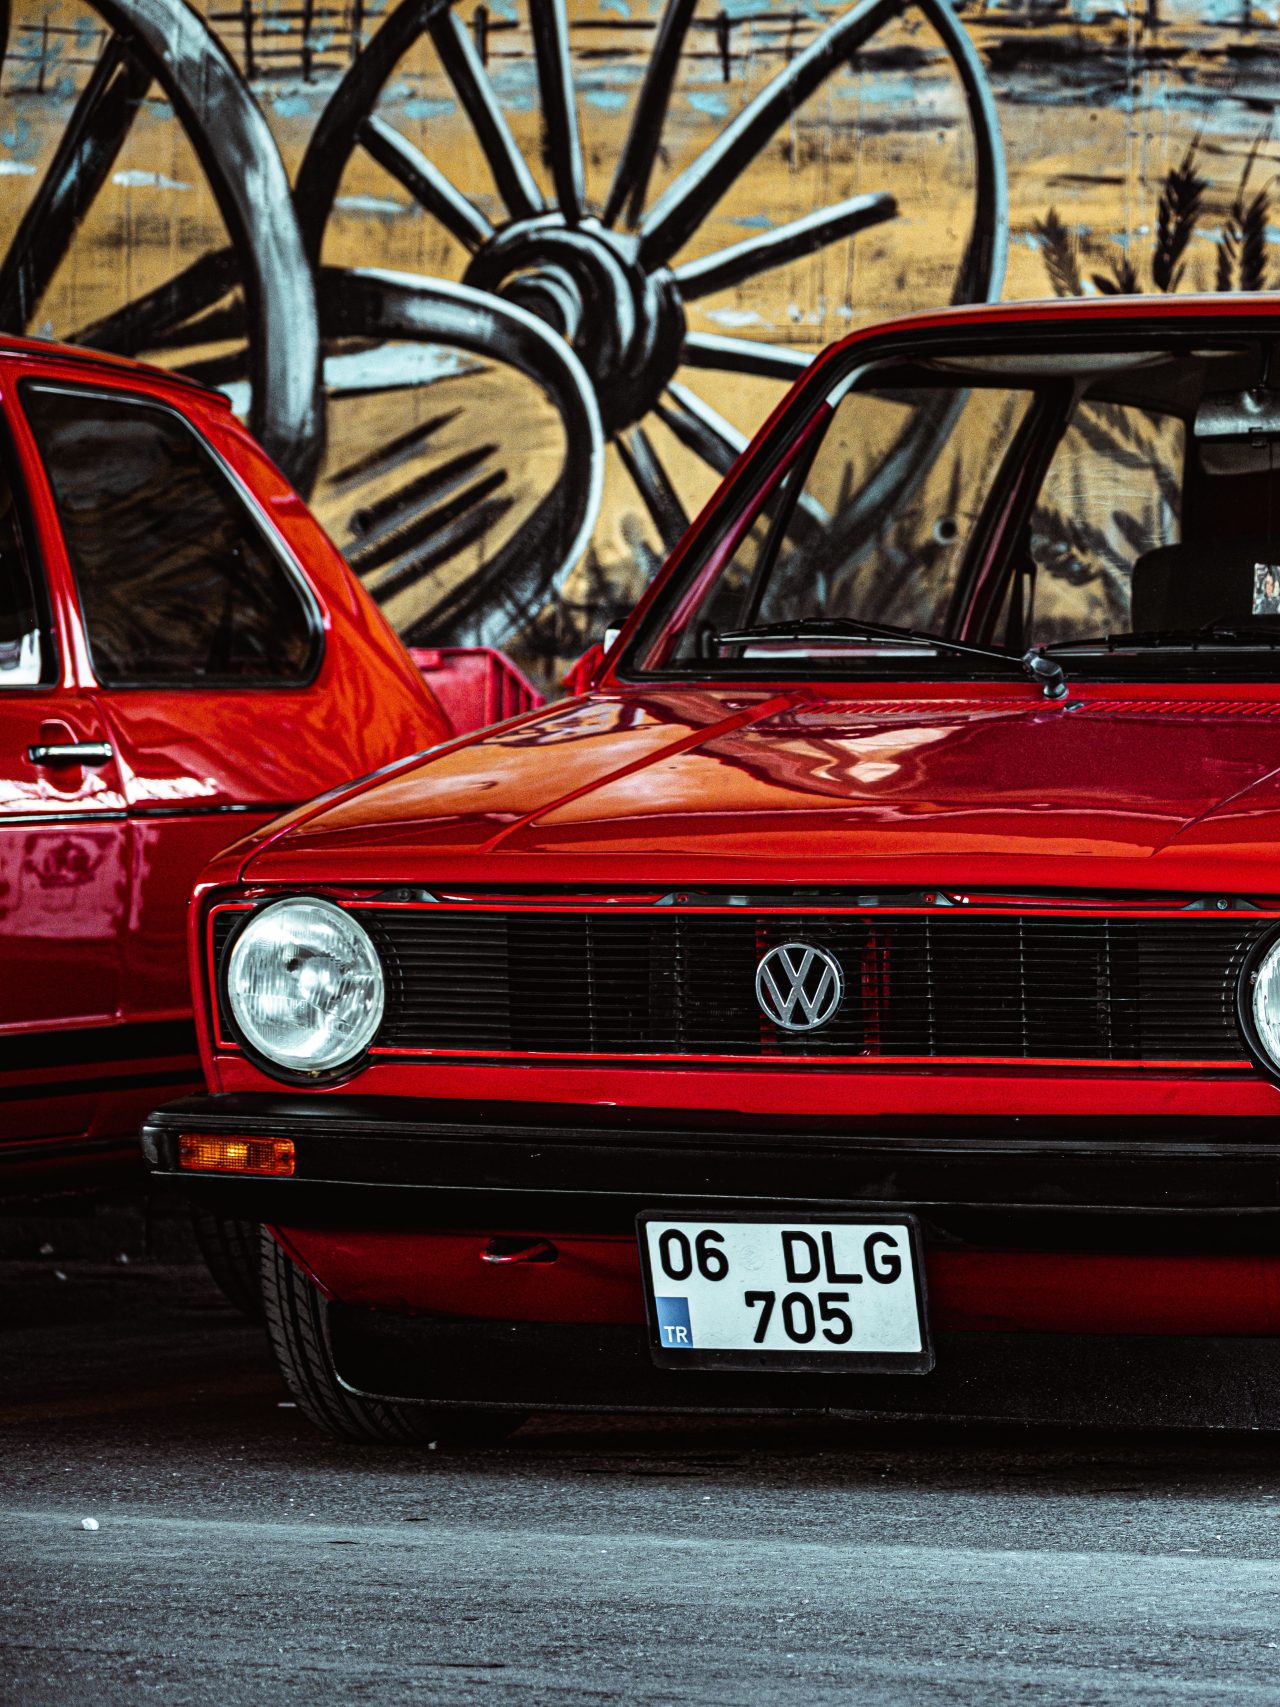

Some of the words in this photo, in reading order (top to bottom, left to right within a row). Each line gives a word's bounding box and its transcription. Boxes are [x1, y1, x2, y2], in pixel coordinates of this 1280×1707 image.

[756, 943, 840, 1030] VW
[659, 1229, 729, 1281] 06
[781, 1231, 902, 1284] DLG
[664, 1326, 688, 1343] TR
[744, 1291, 853, 1344] 705
